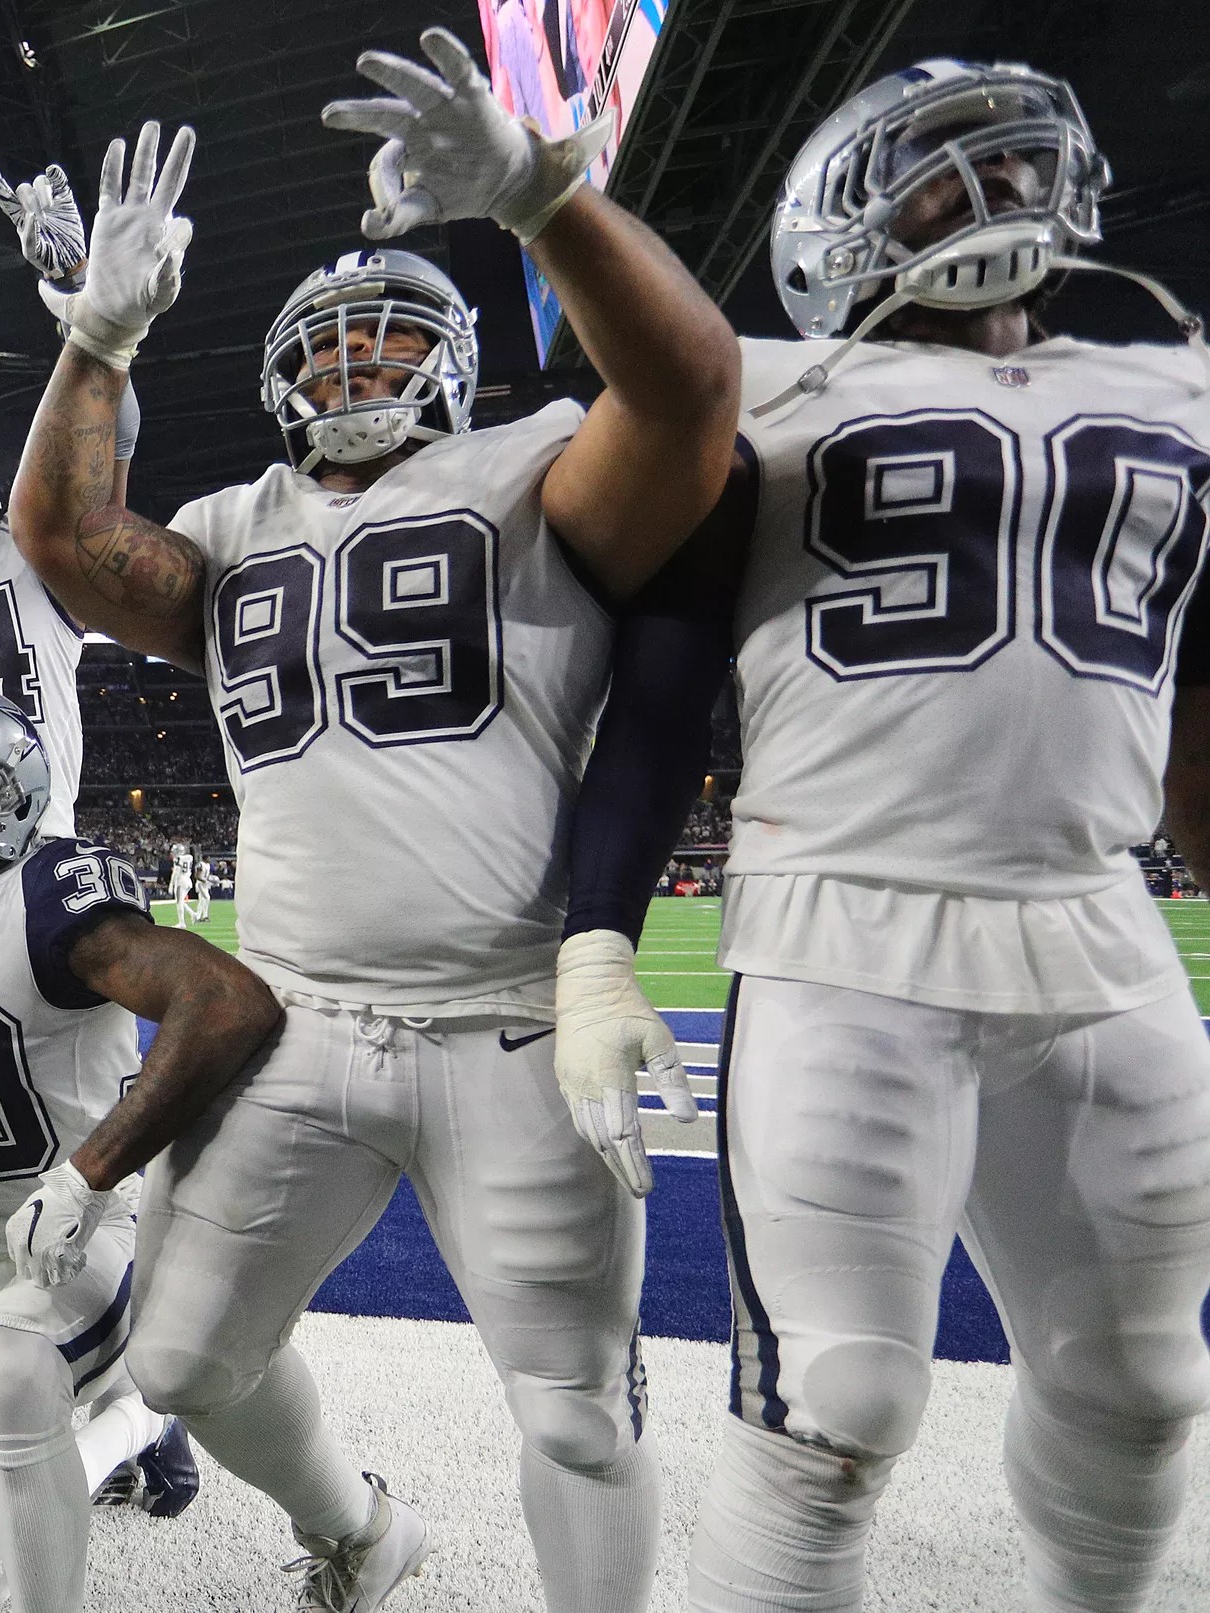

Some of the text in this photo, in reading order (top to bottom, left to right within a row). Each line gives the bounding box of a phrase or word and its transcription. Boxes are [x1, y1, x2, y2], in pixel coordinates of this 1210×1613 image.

[213, 508, 504, 775] 99
[804, 408, 1210, 698] 90
[54, 855, 148, 914] 30
